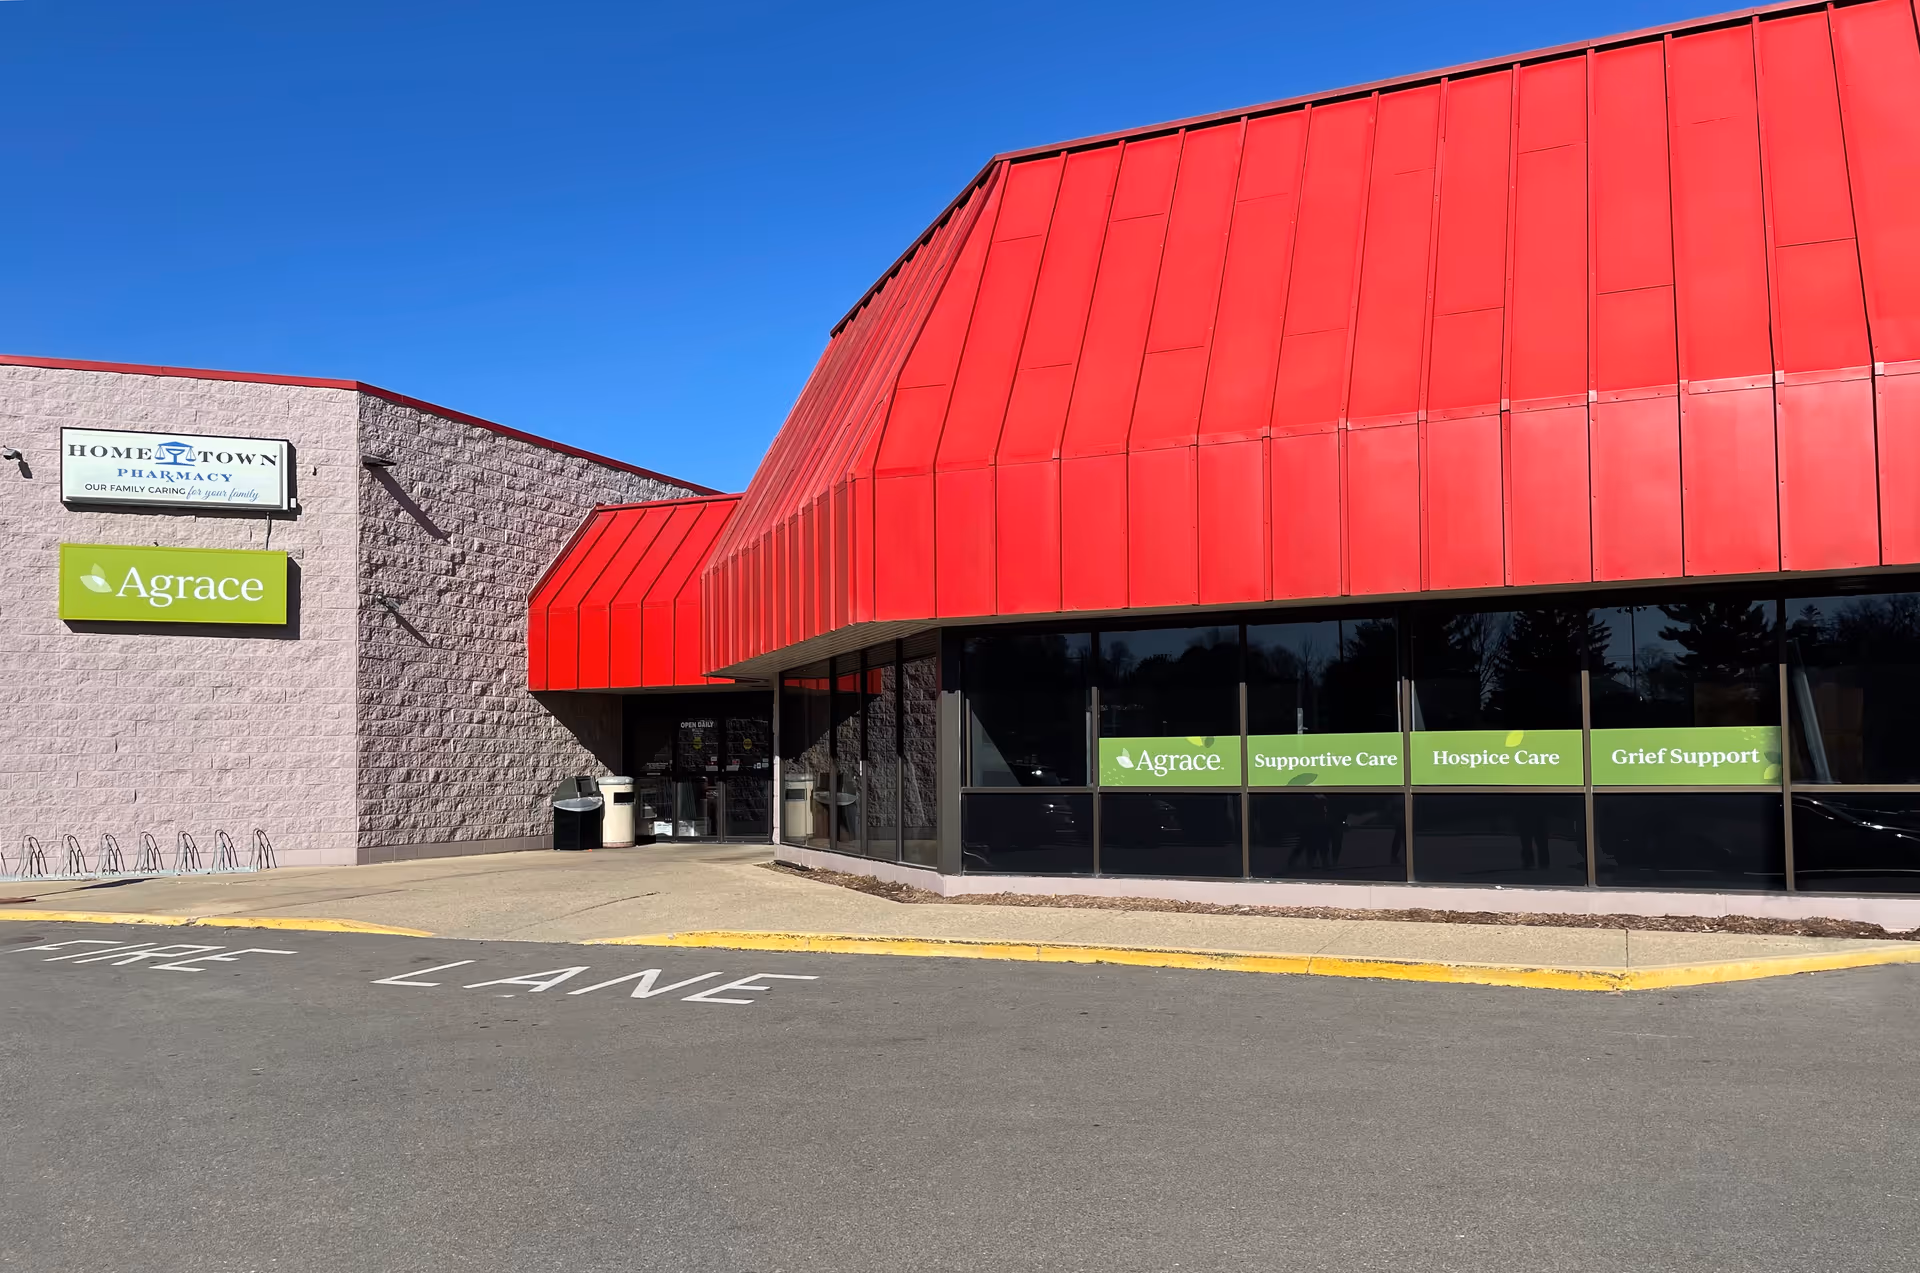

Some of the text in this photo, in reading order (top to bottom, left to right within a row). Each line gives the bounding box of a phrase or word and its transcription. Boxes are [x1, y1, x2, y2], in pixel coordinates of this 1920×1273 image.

[68, 444, 278, 466] HOME TOWN
[117, 468, 233, 483] PHARMACY
[85, 483, 260, 502] OUR FAMILY CARING for your family
[115, 566, 264, 608] Agrace
[1254, 752, 1398, 771] Supportive Care
[1433, 750, 1560, 768] Hospice Care
[1611, 748, 1761, 768] Grief Support
[7, 939, 299, 972] FIRE
[370, 959, 820, 1004] LANE
